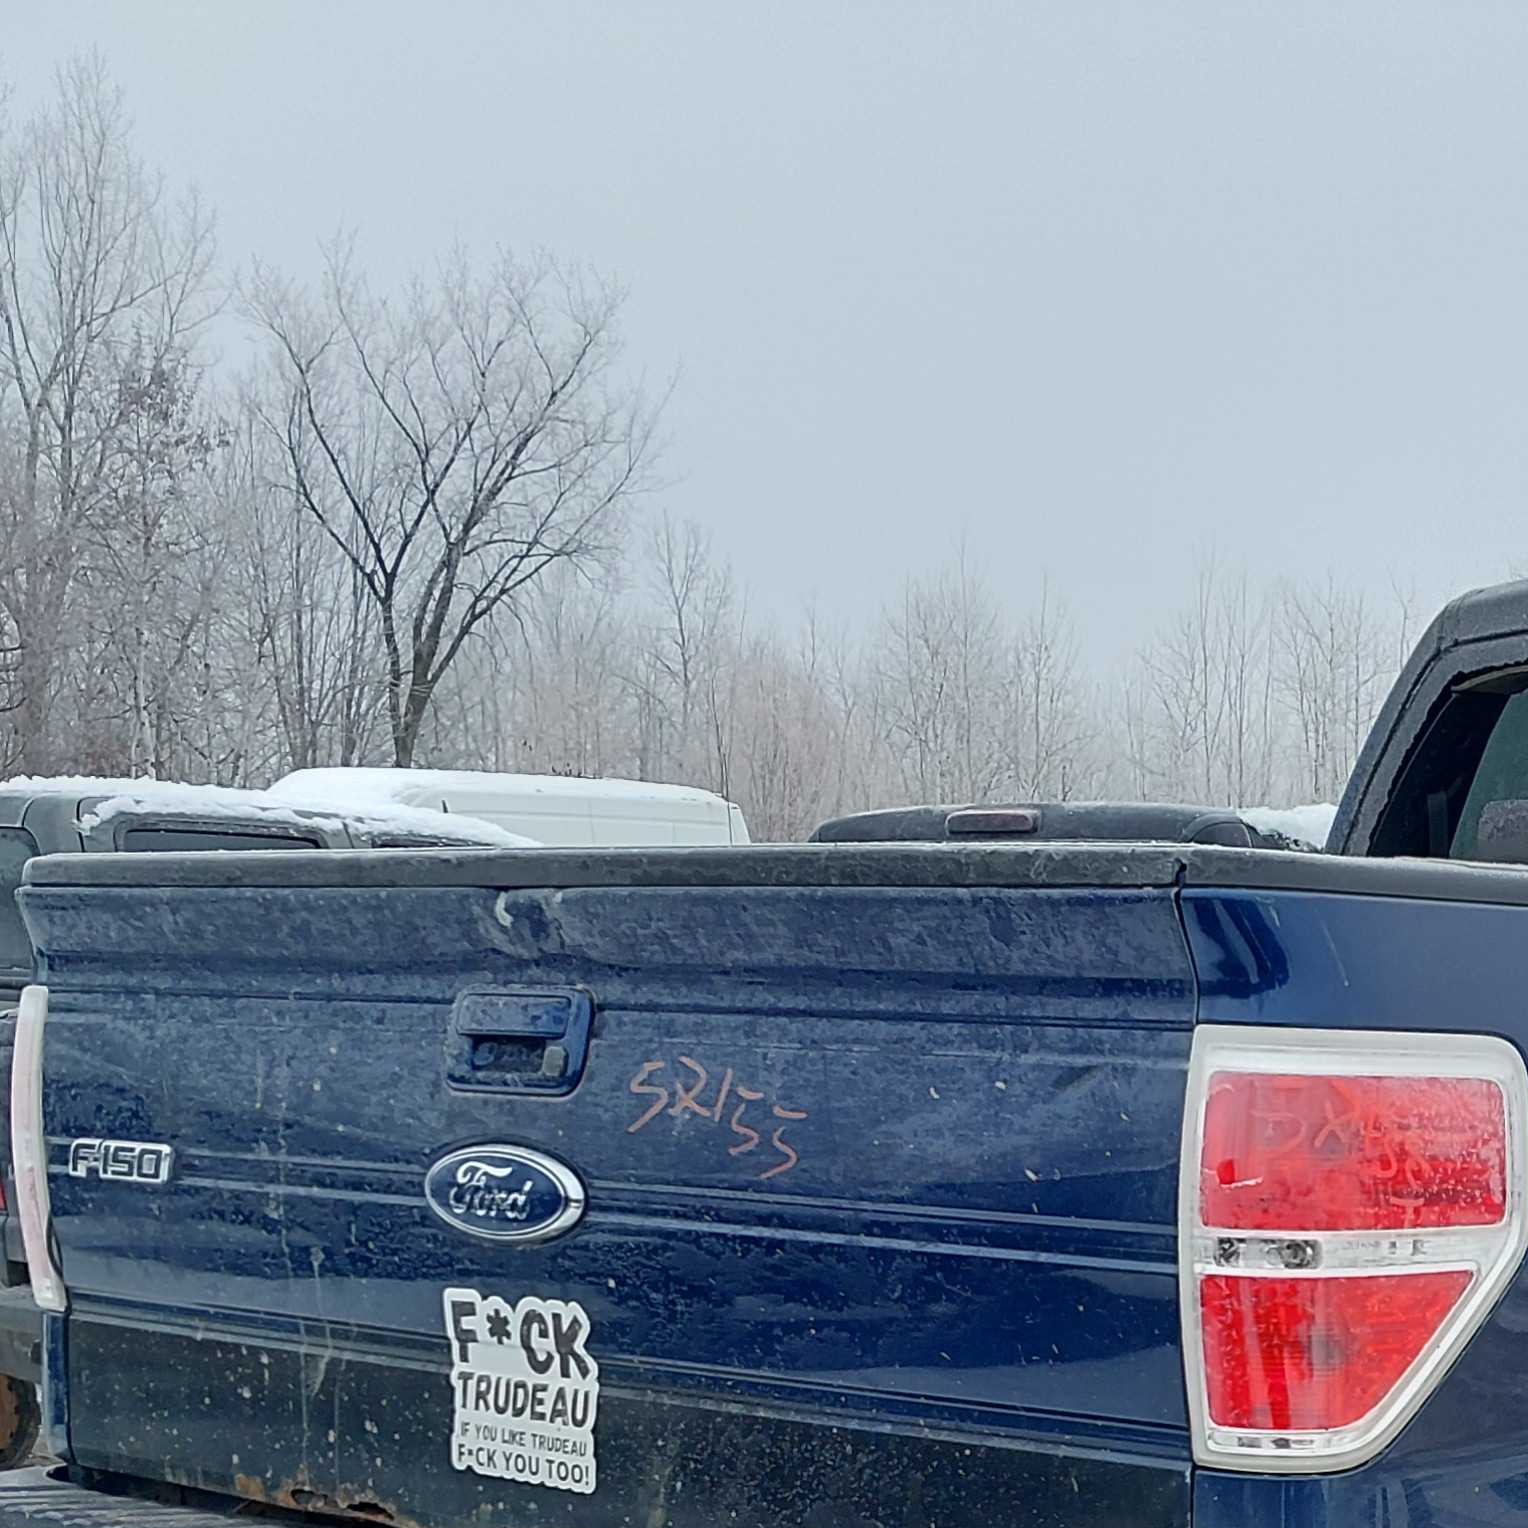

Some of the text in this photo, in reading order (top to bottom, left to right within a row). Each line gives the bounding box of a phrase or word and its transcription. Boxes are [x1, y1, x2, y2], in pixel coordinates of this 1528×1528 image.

[448, 1160, 533, 1221] Ford
[457, 1371, 591, 1428] TRUDEAU
[460, 1421, 588, 1457] IF YOU LIKE TRUDEAU
[501, 1451, 540, 1477] YOU
[546, 1457, 590, 1487] TOO!
